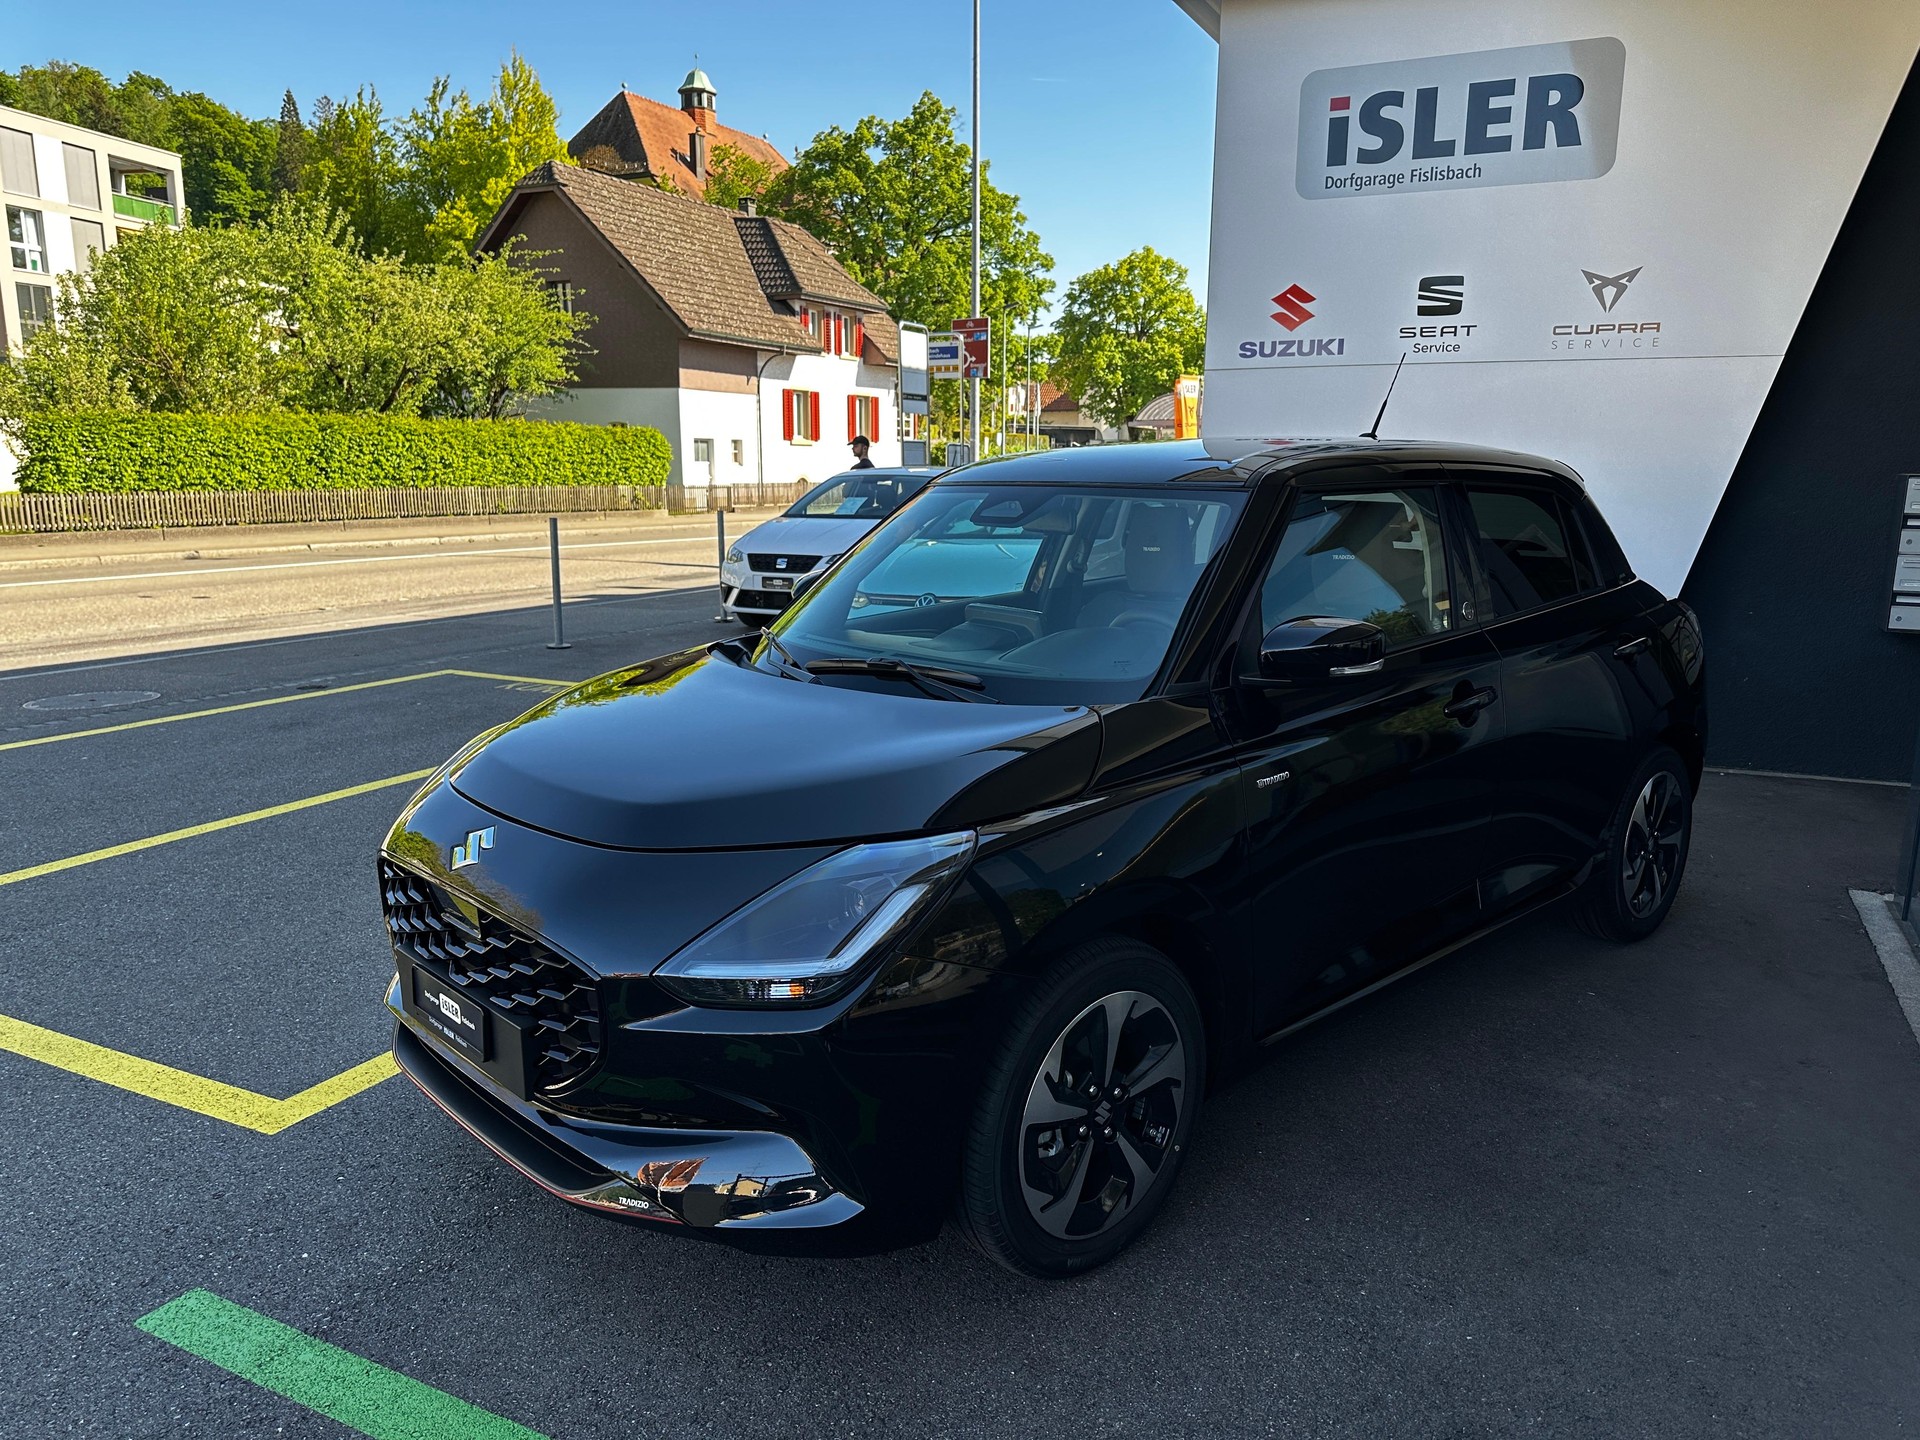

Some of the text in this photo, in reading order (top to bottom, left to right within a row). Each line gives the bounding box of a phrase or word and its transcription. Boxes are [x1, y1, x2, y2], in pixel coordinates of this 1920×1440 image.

[1325, 163, 1482, 191] Dorfgarage Fislisbach
[1399, 324, 1478, 339] SEAT
[1553, 322, 1661, 336] CUPRA
[1239, 338, 1345, 359] SUZUKI
[1413, 341, 1461, 353] Service
[1551, 337, 1660, 350] SERVICE
[618, 1196, 650, 1209] TRADIZIO
